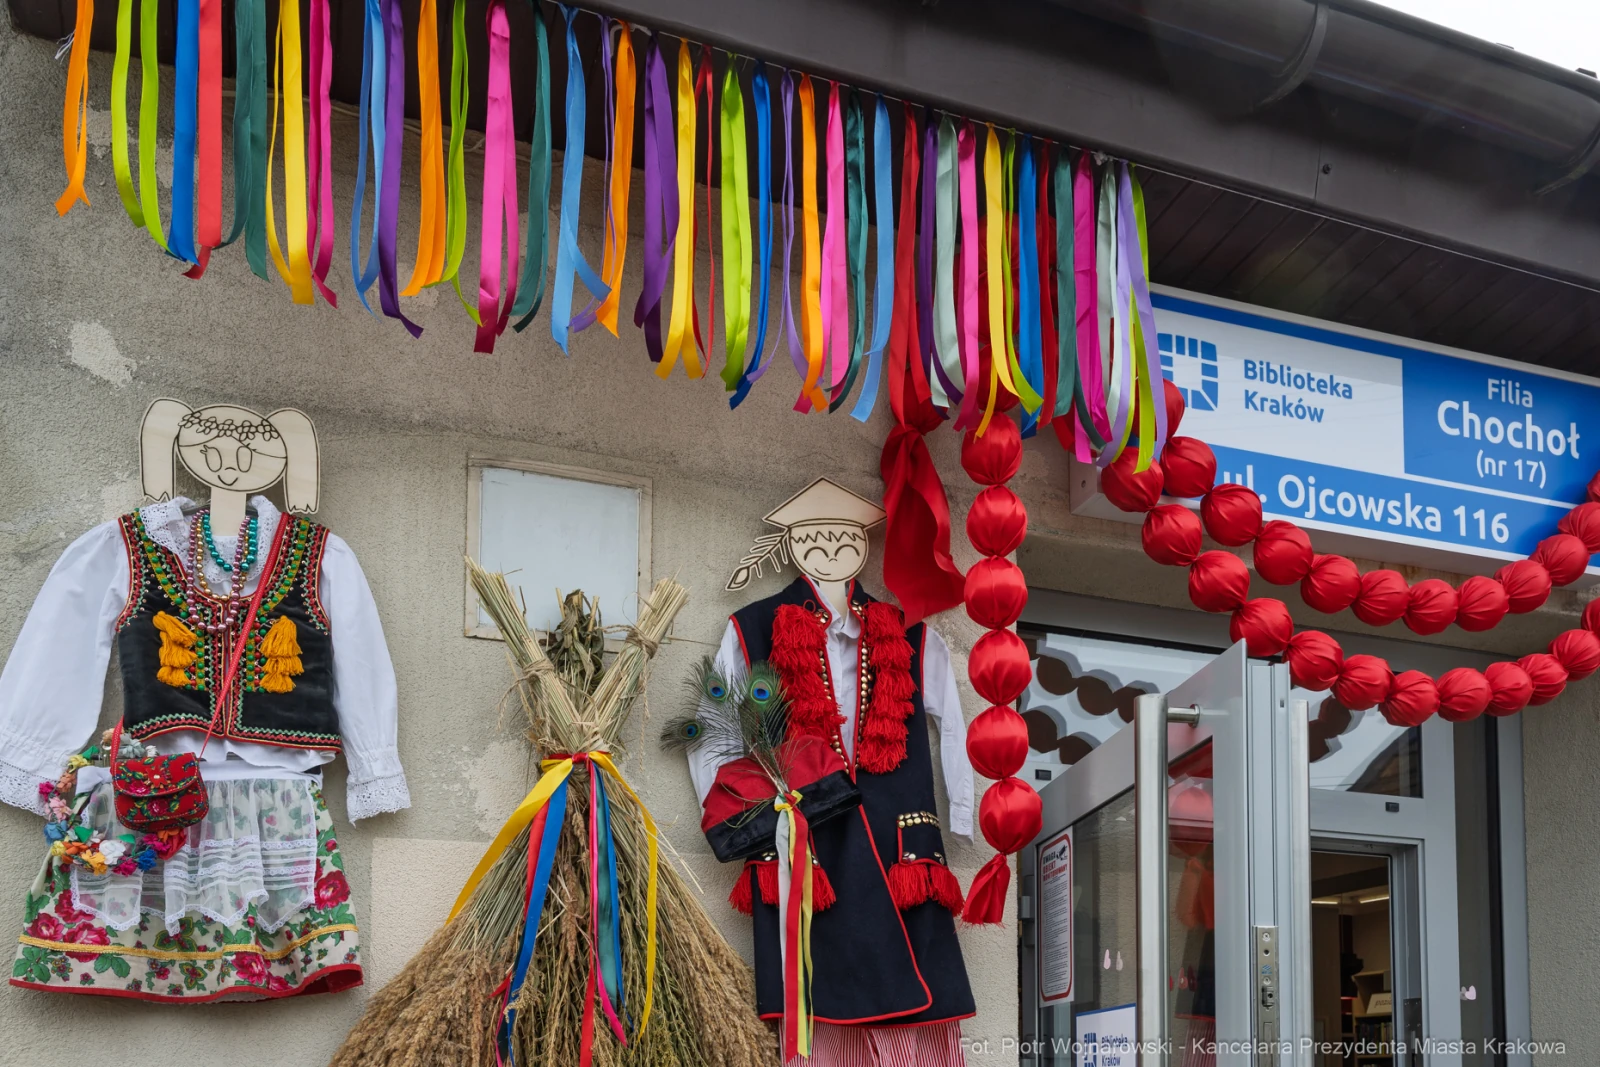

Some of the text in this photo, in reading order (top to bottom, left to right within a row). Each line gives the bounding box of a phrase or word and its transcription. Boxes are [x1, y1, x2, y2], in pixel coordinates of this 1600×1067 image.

[1244, 359, 1352, 399] Biblioteka
[1488, 378, 1533, 408] Filia
[1244, 389, 1324, 423] Kraków
[1437, 400, 1580, 459] Chochoł
[1477, 449, 1546, 489] (nr 17)
[1278, 474, 1441, 532] Ojcowska
[1453, 505, 1509, 544] 116
